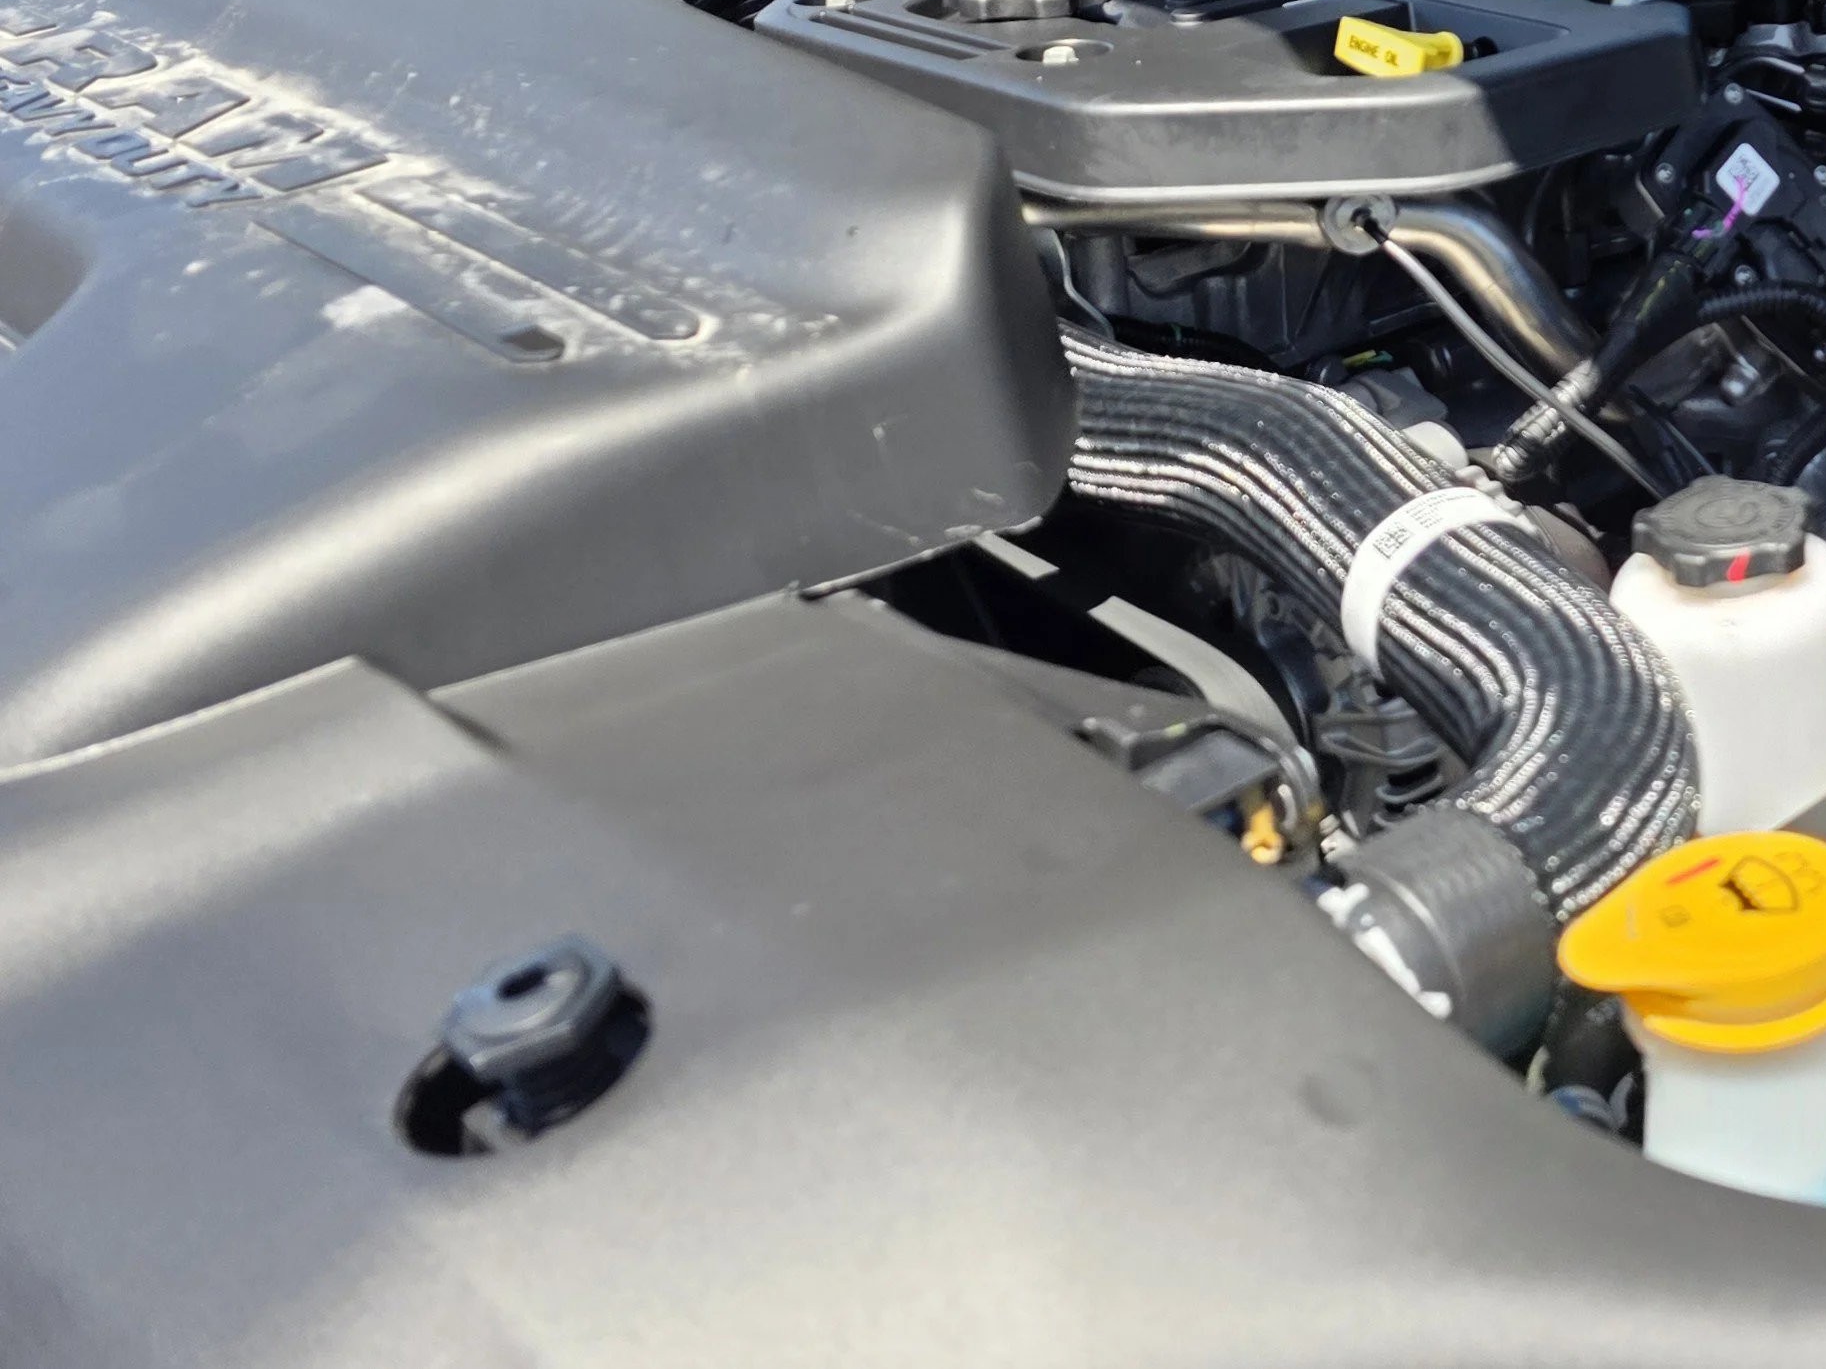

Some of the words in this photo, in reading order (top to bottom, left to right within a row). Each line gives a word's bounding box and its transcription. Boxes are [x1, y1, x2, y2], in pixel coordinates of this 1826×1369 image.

[1348, 35, 1379, 58] ENGINE
[1384, 50, 1399, 67] OIL
[75, 131, 264, 208] DUTY
